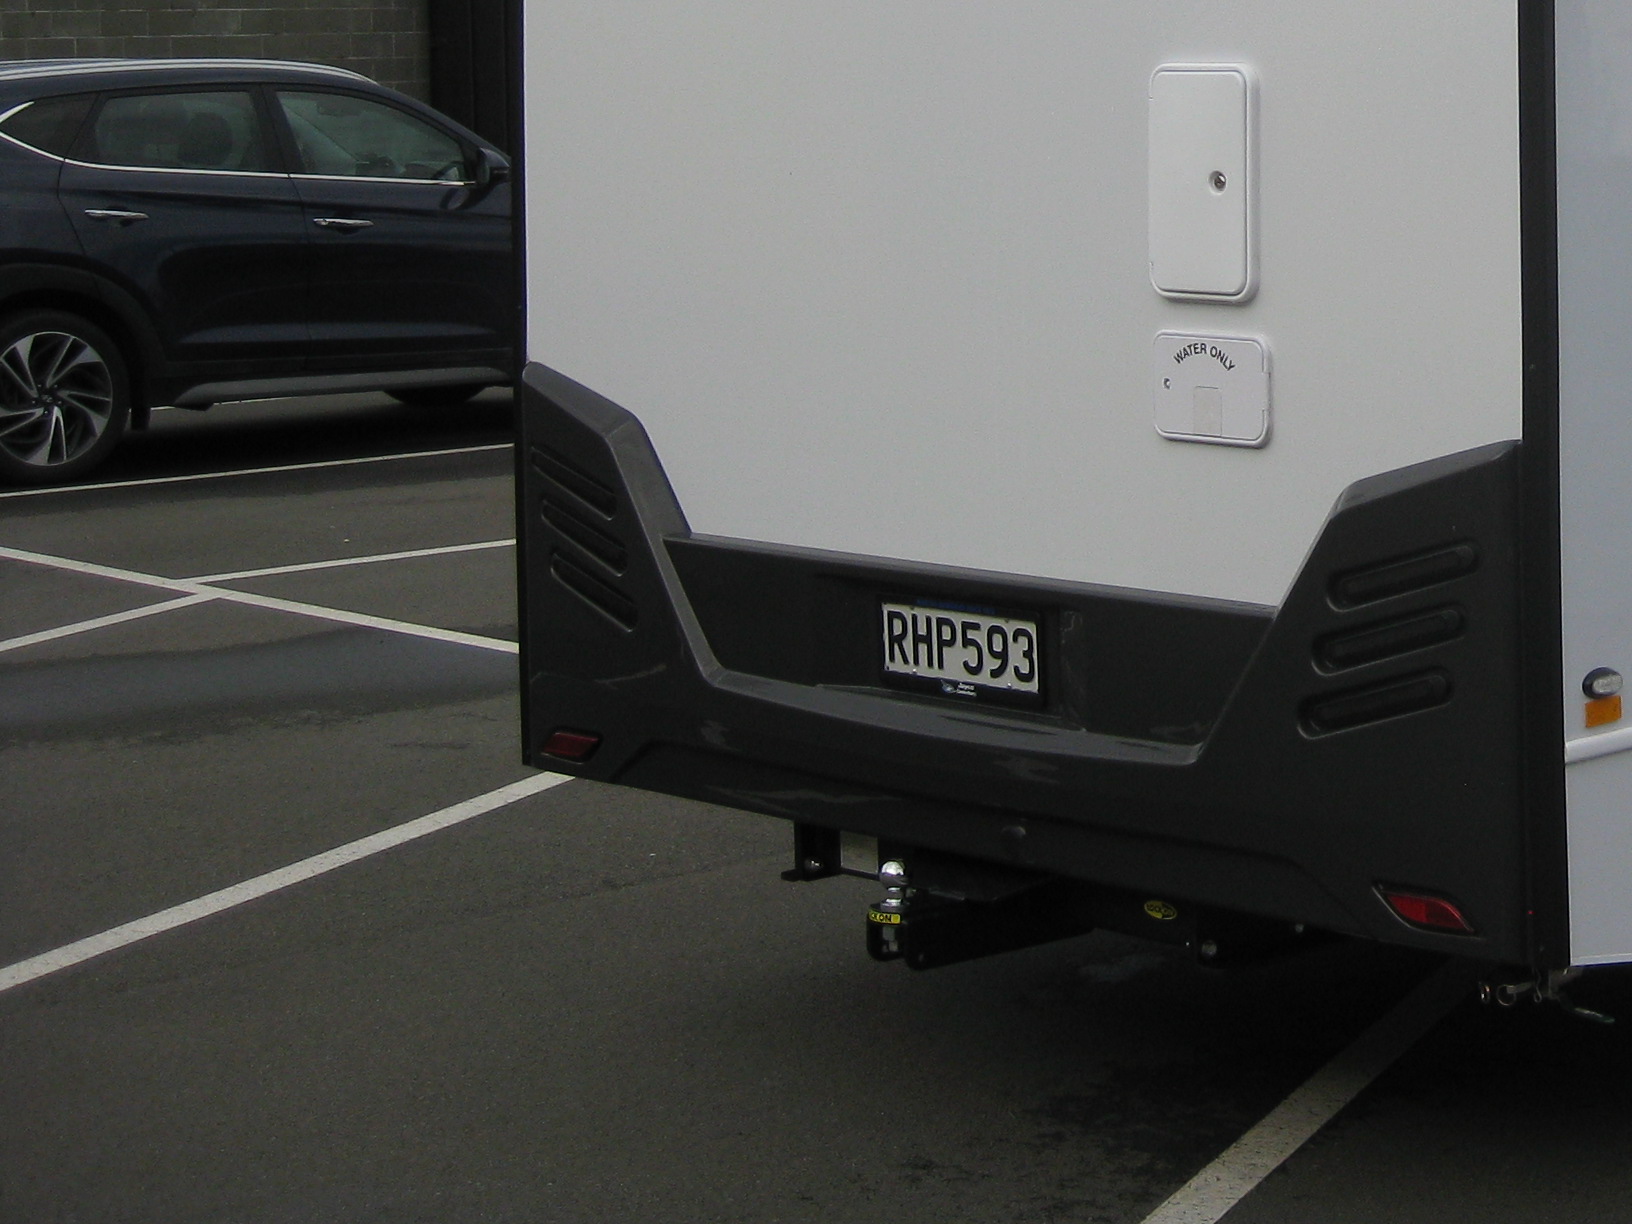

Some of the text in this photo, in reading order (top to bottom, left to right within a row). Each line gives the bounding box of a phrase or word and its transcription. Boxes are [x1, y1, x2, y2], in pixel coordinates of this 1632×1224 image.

[1173, 342, 1237, 372] WATER ONLY
[886, 610, 1036, 684] RHP593
